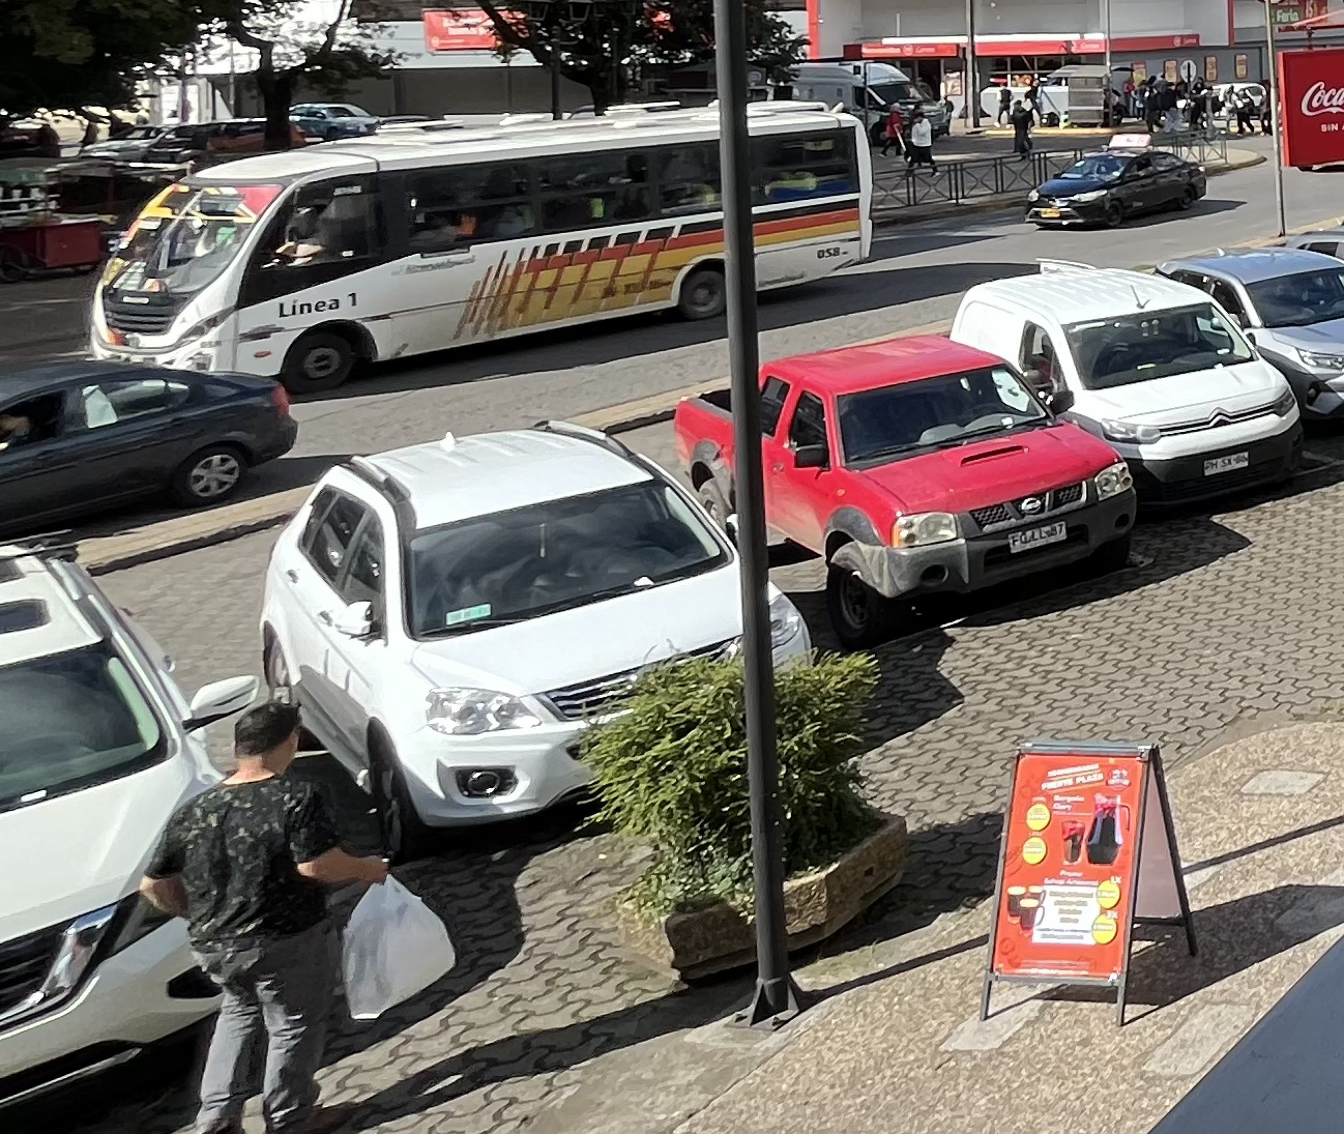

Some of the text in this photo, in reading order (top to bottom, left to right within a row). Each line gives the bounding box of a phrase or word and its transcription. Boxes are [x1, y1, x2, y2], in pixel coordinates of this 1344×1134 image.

[1320, 122, 1339, 133] SIN
[279, 293, 357, 318] Línea 1
